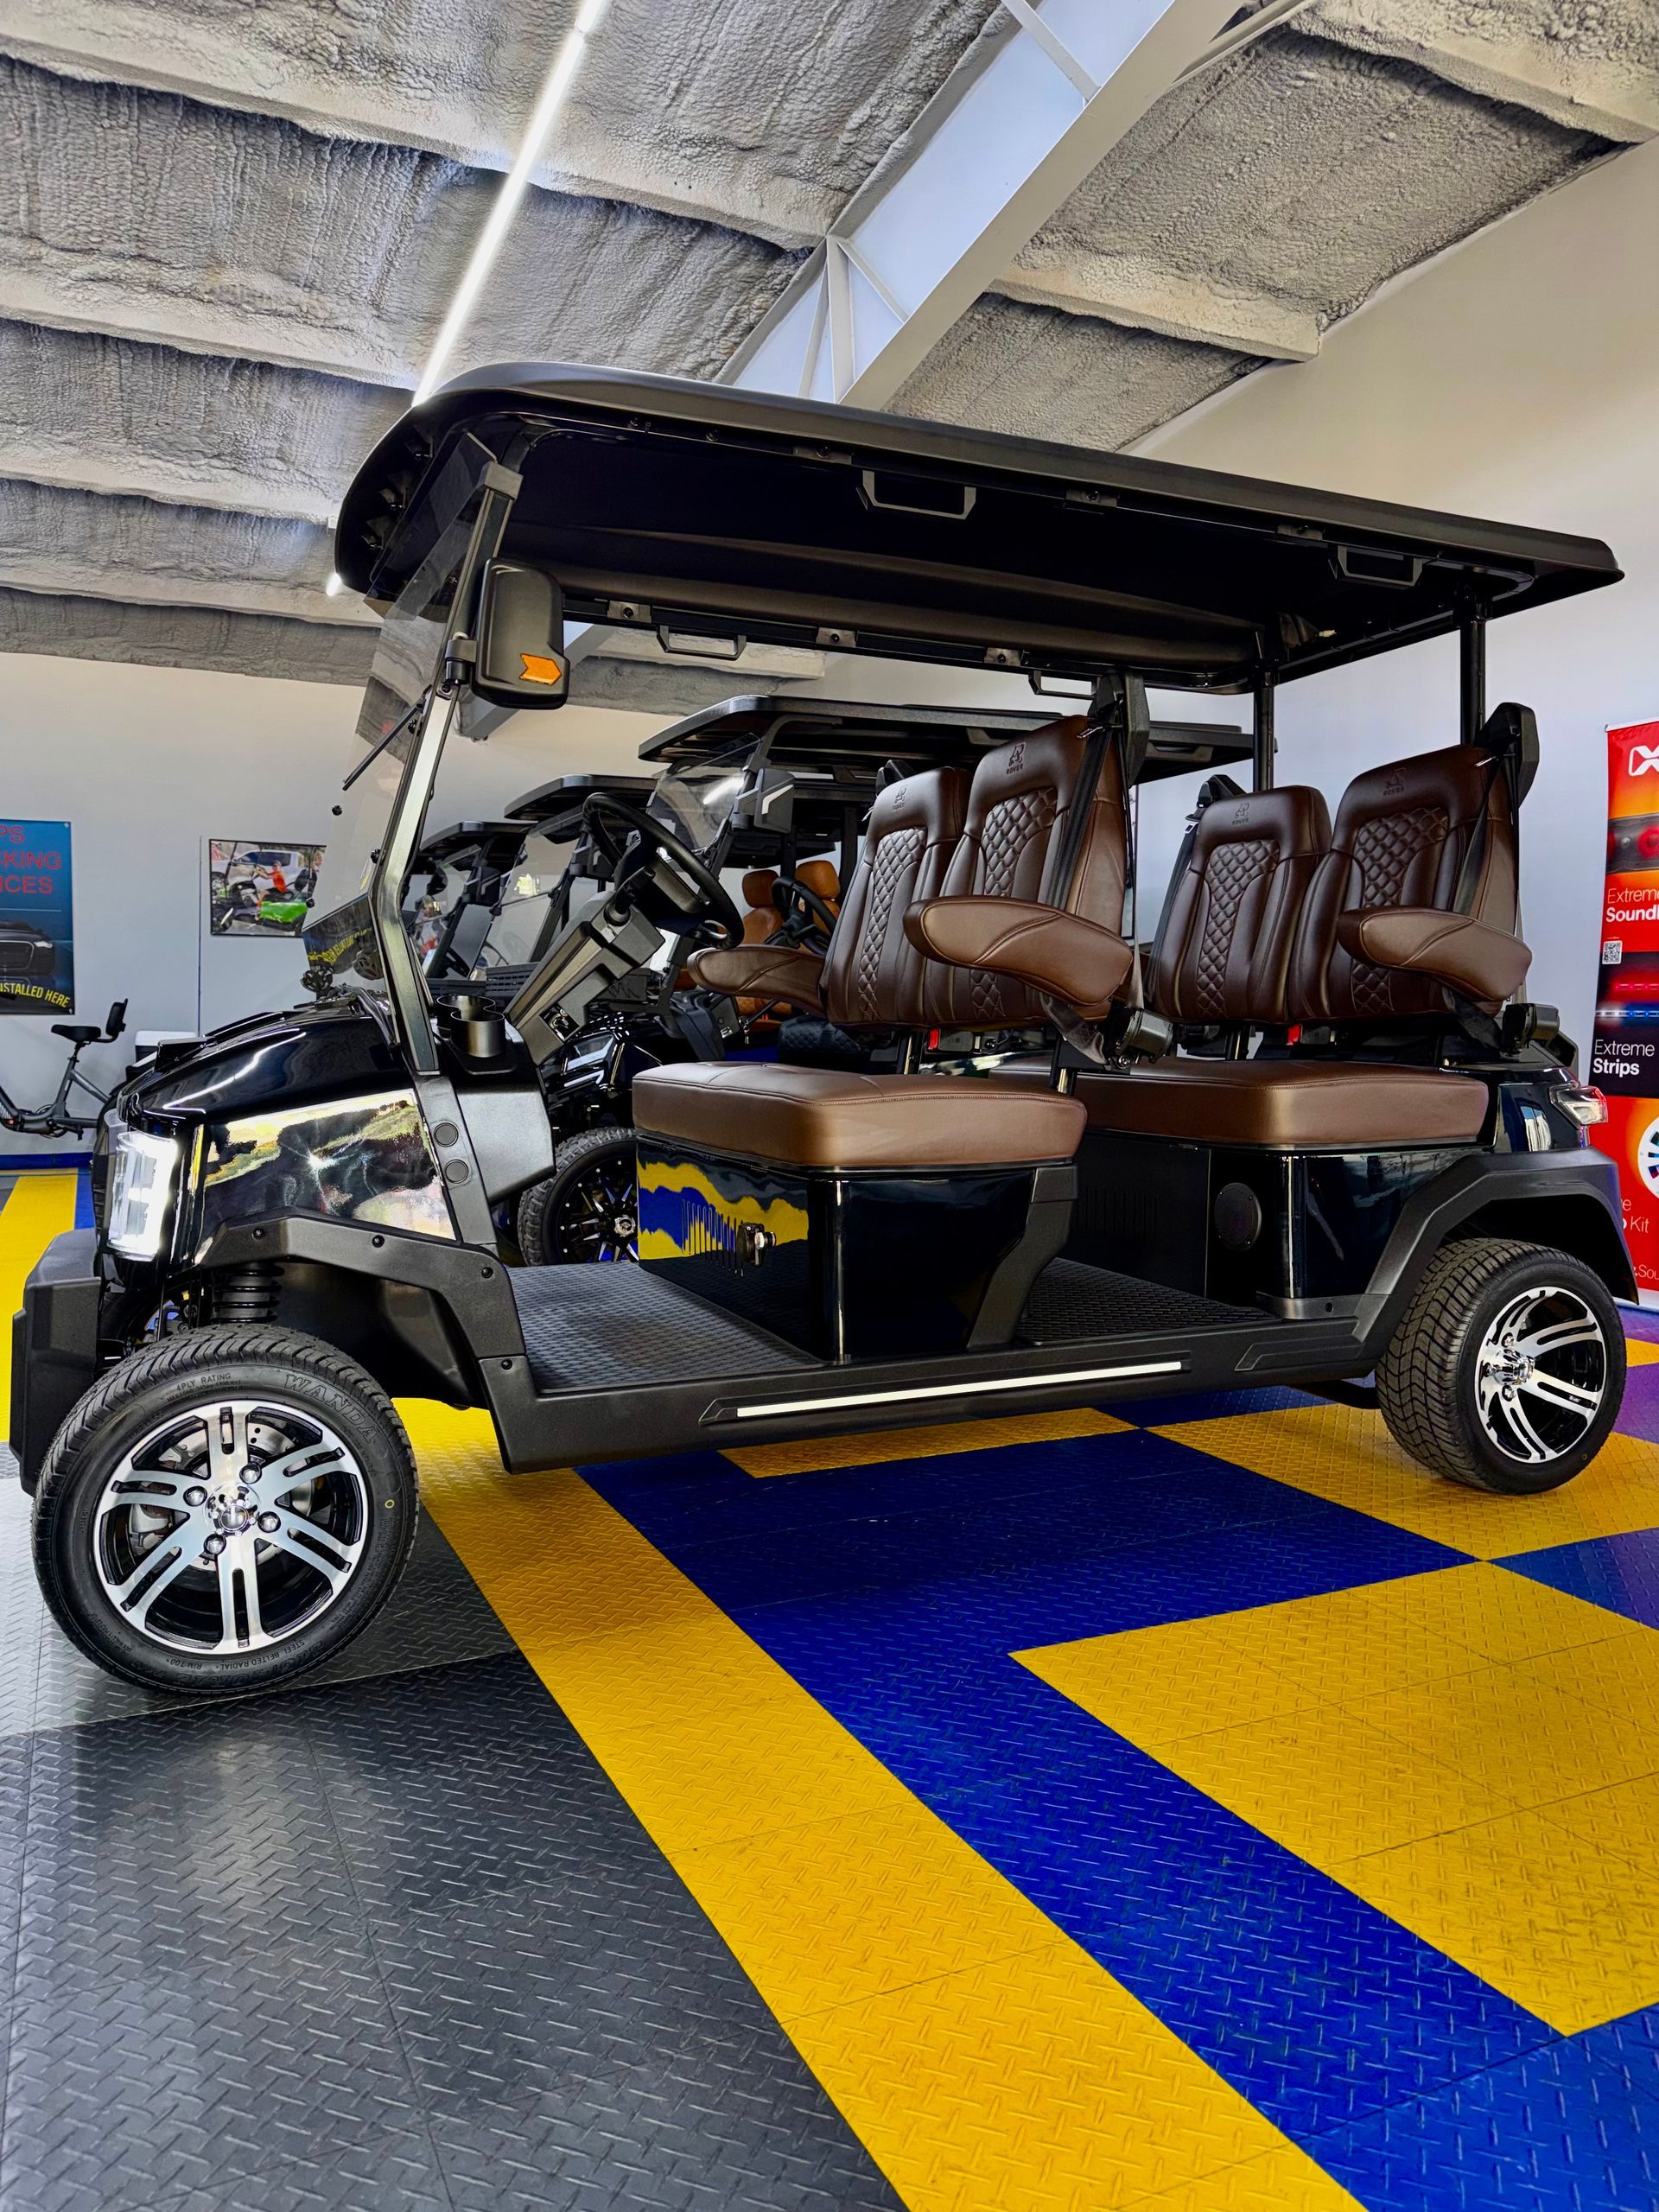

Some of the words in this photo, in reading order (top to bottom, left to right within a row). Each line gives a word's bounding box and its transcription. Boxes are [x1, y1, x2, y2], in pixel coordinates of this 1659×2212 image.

[1007, 764, 1024, 775] ROVER
[1383, 786, 1405, 796] ROVER
[0, 849, 62, 870] KING
[1607, 887, 1659, 905] Extrem
[44, 989, 71, 1008] HERE
[1594, 1039, 1656, 1057] Extreme
[1592, 1057, 1640, 1078] Strips
[1630, 1215, 1649, 1234] Kit
[175, 1379, 196, 1391] 4PLY
[200, 1372, 232, 1384] RATING
[284, 1374, 378, 1444] WANDA
[283, 1637, 305, 1654] STEEL
[220, 1658, 250, 1670] RADIAL
[251, 1650, 280, 1667] BELTED
